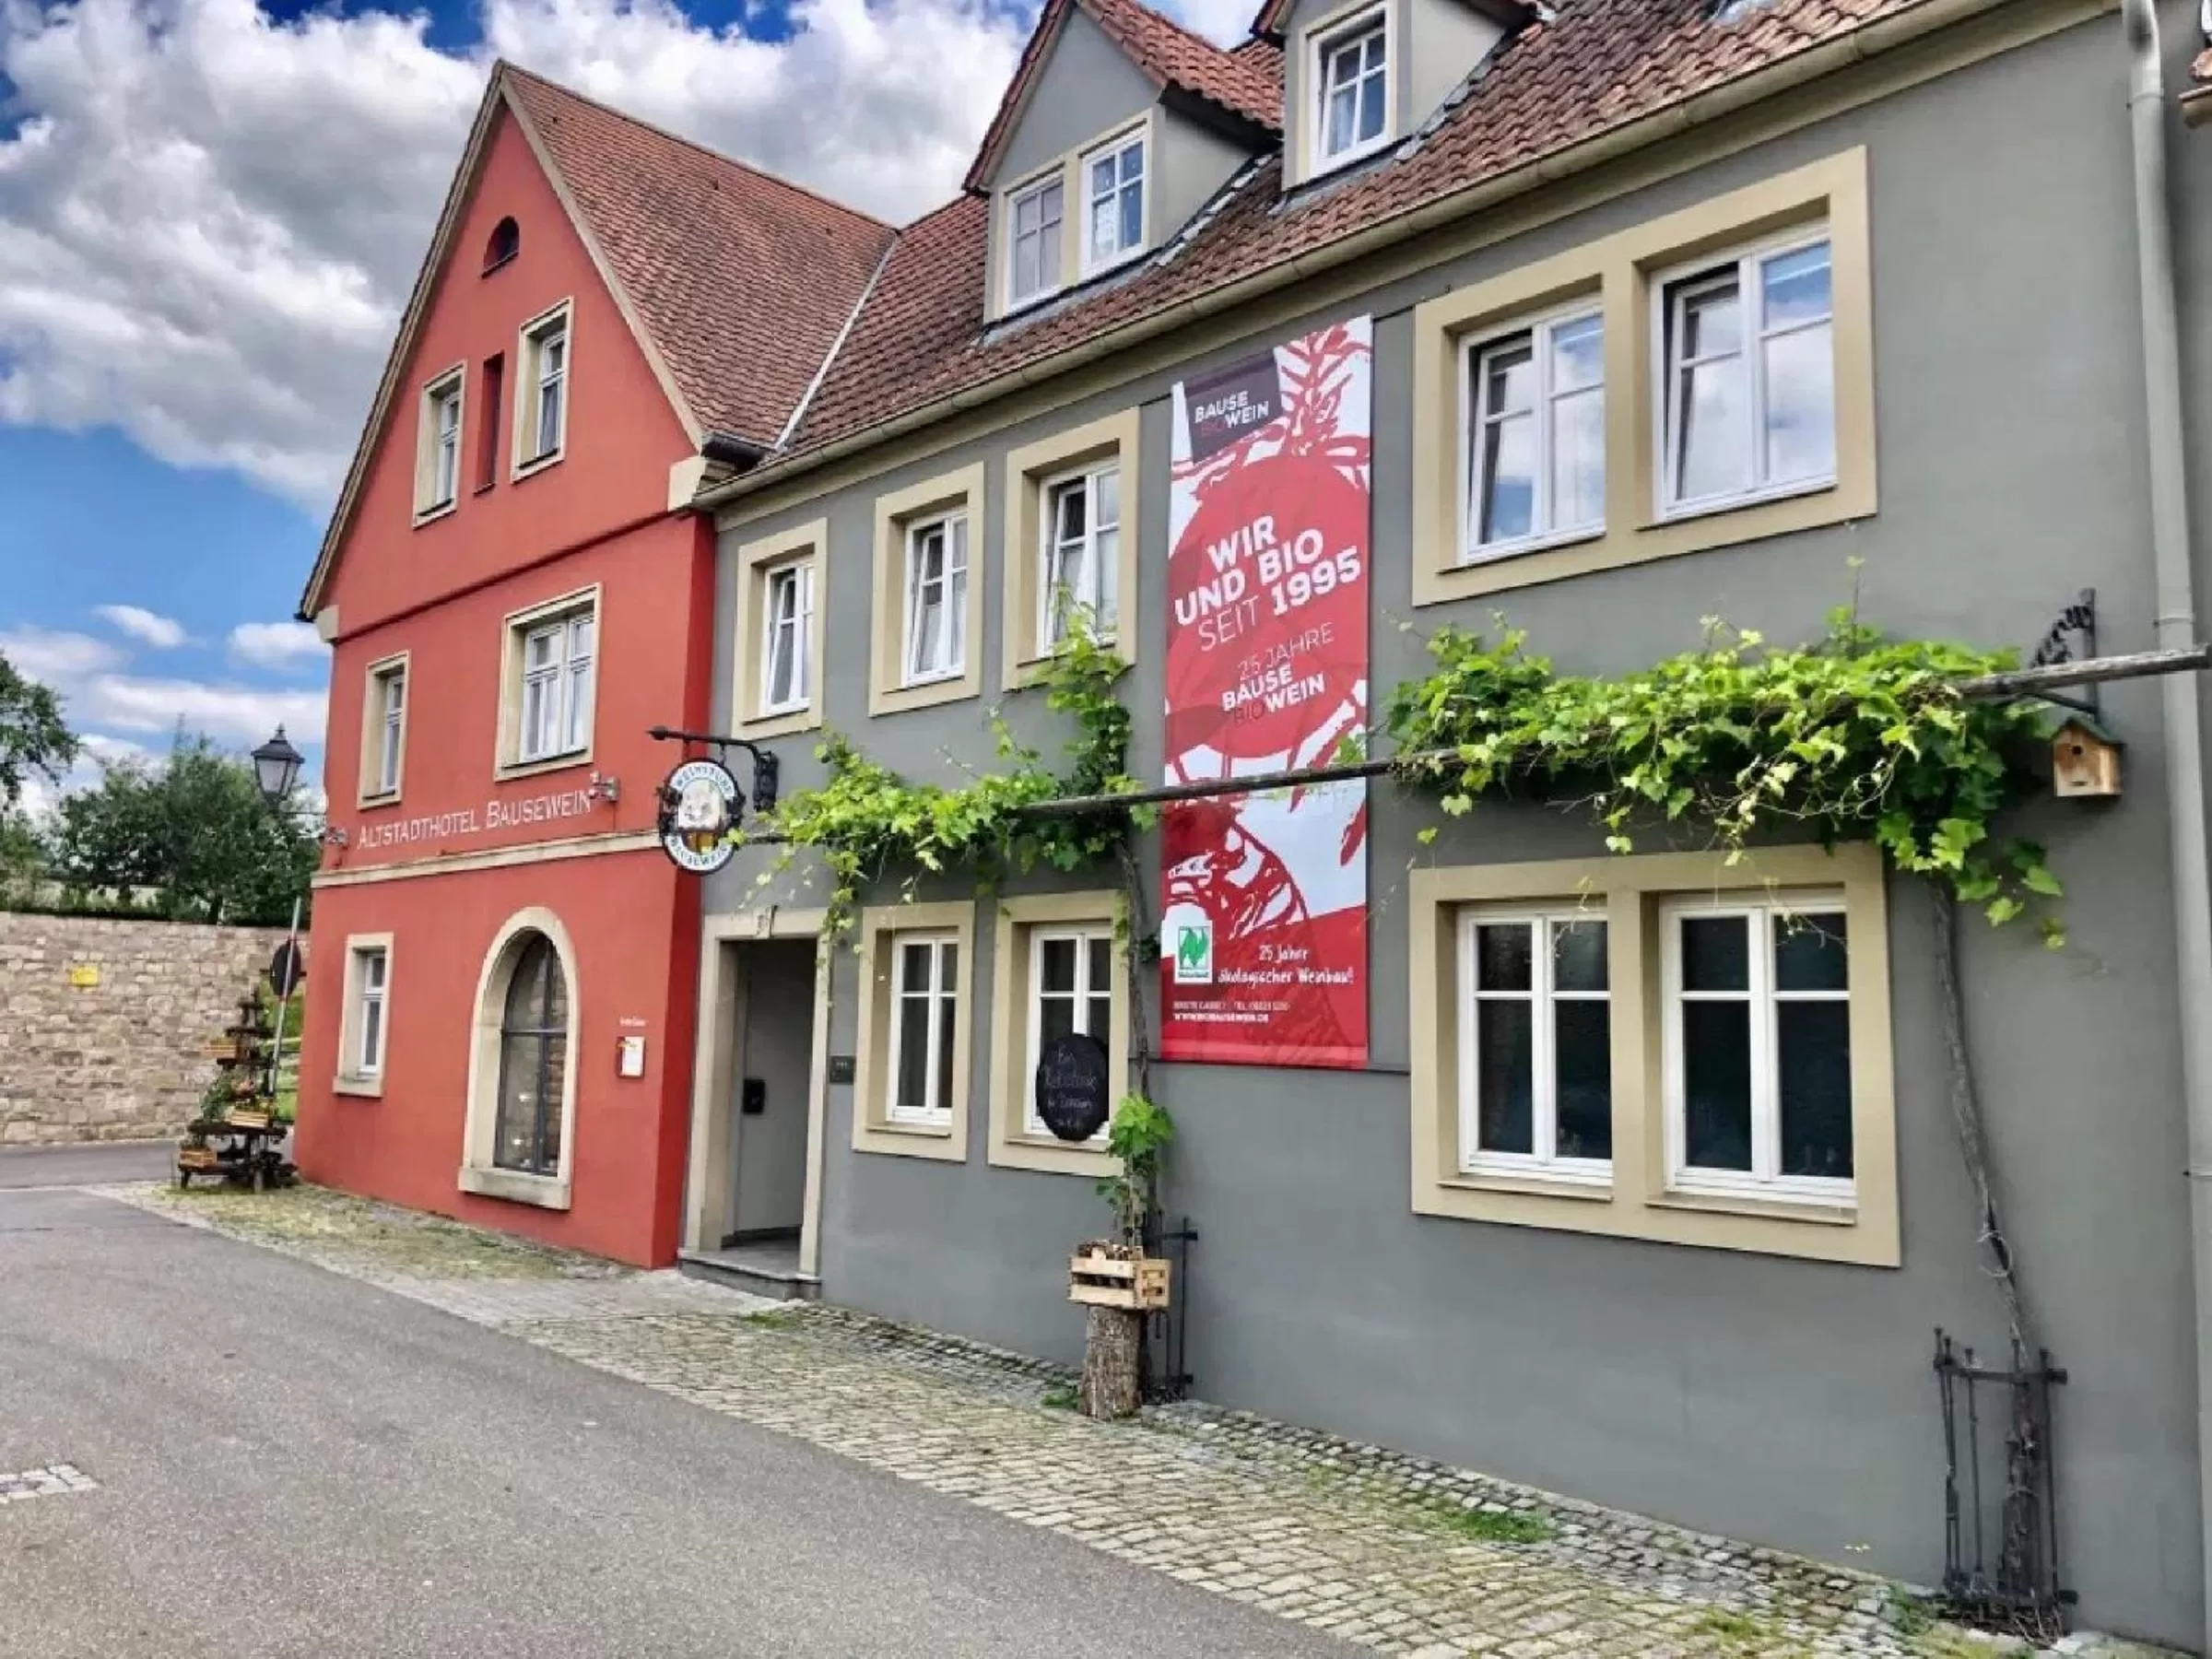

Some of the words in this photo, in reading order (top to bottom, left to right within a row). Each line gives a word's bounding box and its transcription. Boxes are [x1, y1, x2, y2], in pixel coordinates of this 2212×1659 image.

[1194, 391, 1248, 423] BAUSE
[1225, 401, 1269, 429] WEIN
[1206, 515, 1277, 572] WIR
[1174, 568, 1245, 626] UND
[1258, 529, 1324, 586] BIO
[1198, 594, 1259, 652] SEIT
[1271, 546, 1360, 616] 1995
[1238, 653, 1260, 681] 25
[1266, 621, 1335, 668] JAHRE
[1221, 663, 1293, 712] BAUSE
[1264, 671, 1325, 712] WEIN
